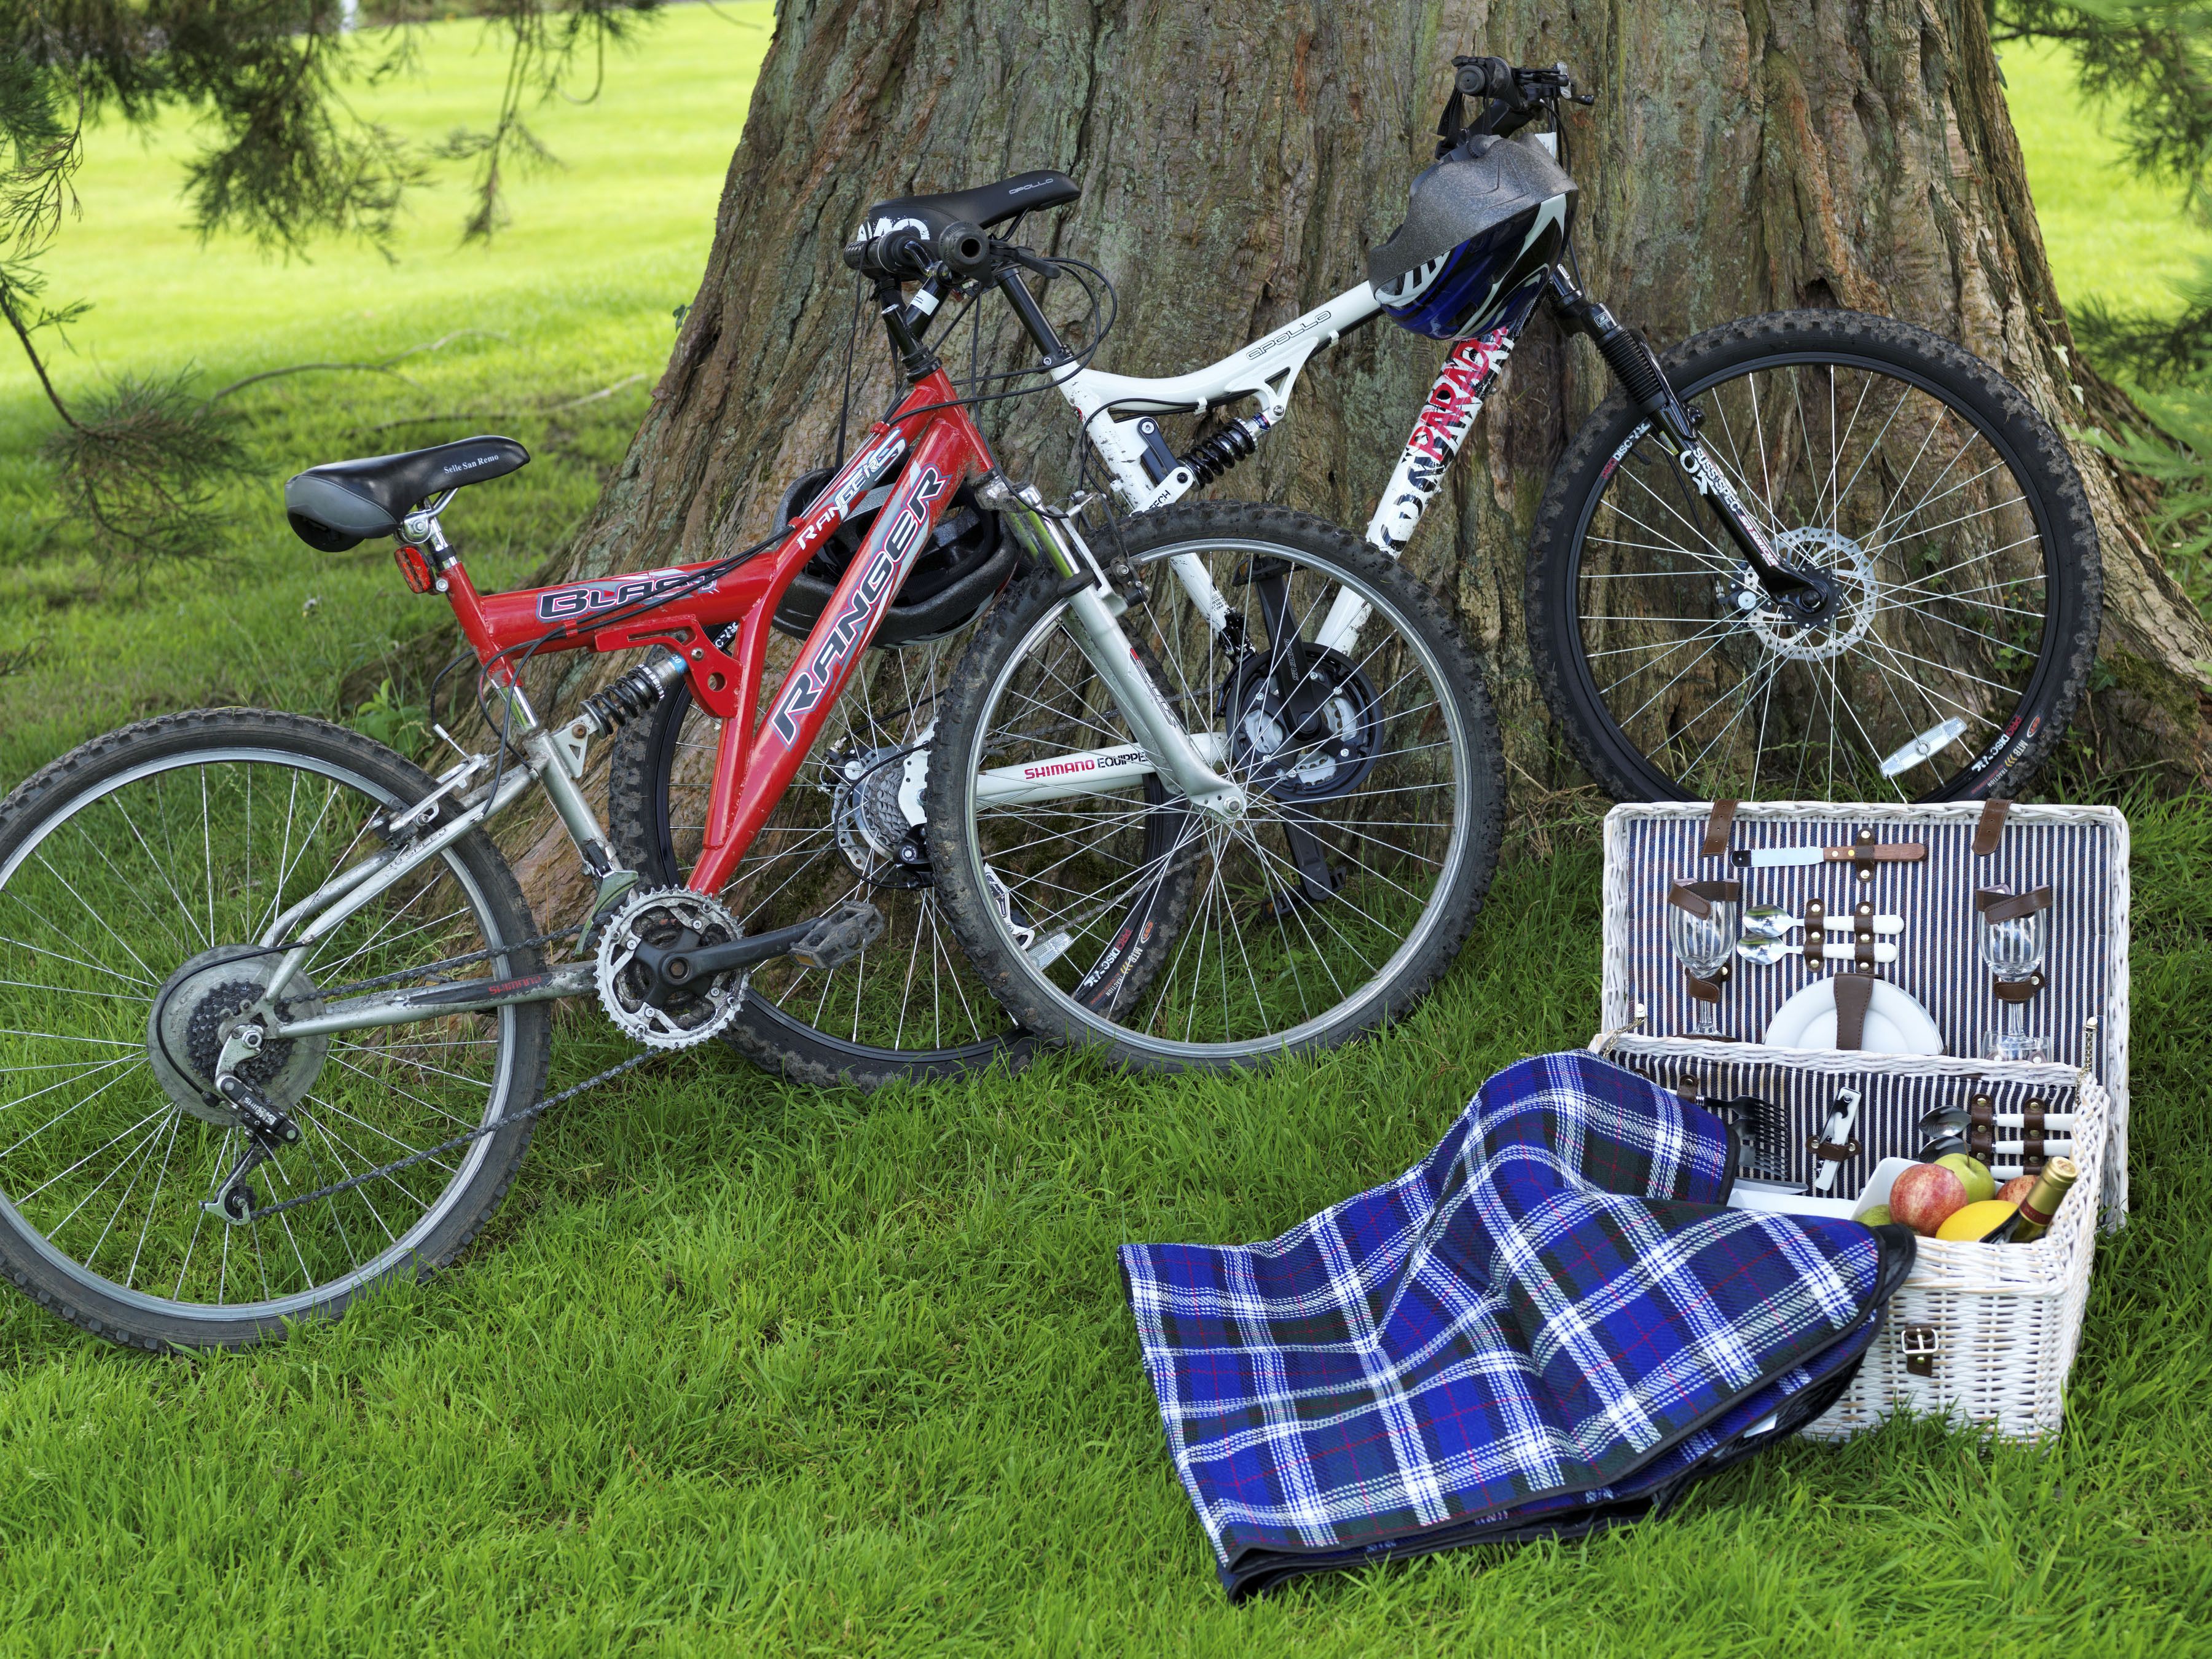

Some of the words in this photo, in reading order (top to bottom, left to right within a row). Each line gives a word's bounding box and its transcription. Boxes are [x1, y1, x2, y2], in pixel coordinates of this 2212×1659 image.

[1008, 178, 1054, 195] APOLLO
[1245, 310, 1332, 360] APOLLO
[1408, 326, 1509, 462] PARADO
[443, 465, 463, 474] Selle
[462, 461, 477, 470] San
[477, 454, 500, 466] Remo
[1714, 480, 1741, 512] SPEC
[1752, 530, 1780, 566] SUNTOUR
[771, 466, 946, 747] RANGER
[2013, 739, 2029, 757] MTB
[1024, 759, 1096, 780] SHIMANO
[1097, 751, 1148, 769] EQUIPPE
[1986, 767, 2008, 788] TRACTION
